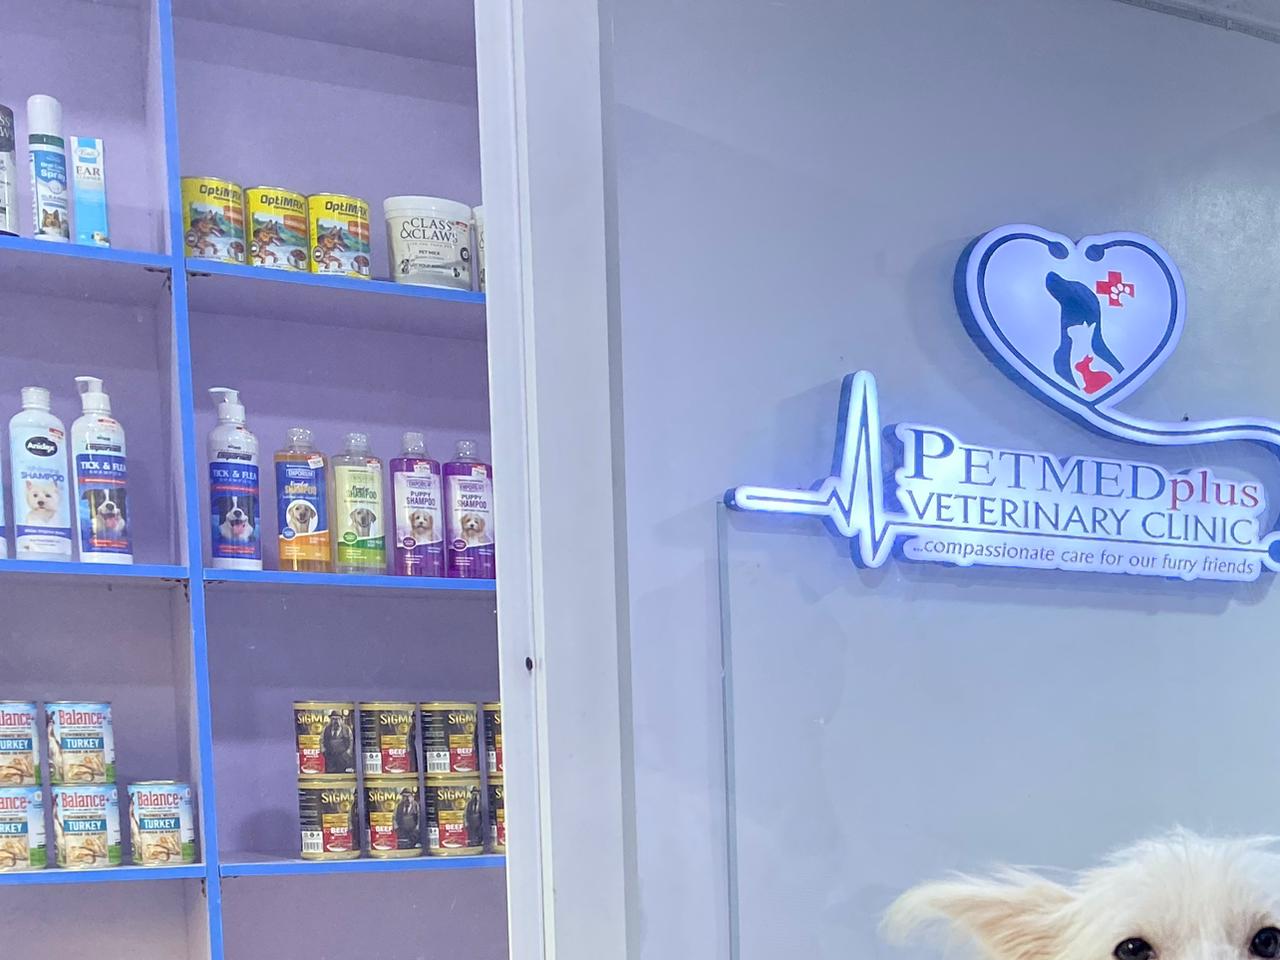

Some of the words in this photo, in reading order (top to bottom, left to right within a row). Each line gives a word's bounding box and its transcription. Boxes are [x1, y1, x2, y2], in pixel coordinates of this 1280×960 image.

[76, 165, 100, 177] EAR
[410, 217, 453, 231] CLASS
[80, 461, 100, 470] TICK
[103, 462, 111, 470] &
[21, 471, 64, 482] SHAMPOO
[213, 469, 230, 478] TICK
[232, 470, 240, 478] &
[406, 497, 436, 506] SHAMPOO
[457, 500, 487, 509] SHAMPOO
[906, 489, 1131, 536] VETERINARY
[1141, 511, 1253, 545] CLINIC
[1061, 550, 1095, 564] care
[1101, 549, 1124, 566] for
[1129, 555, 1157, 568] our
[1162, 553, 1198, 573] furry
[1203, 556, 1254, 575] friends
[0, 710, 31, 726] lance
[0, 739, 29, 749] URKEY
[67, 738, 99, 748] TURKEY
[68, 820, 102, 831] TURKEY
[143, 819, 176, 829] TURKEY
